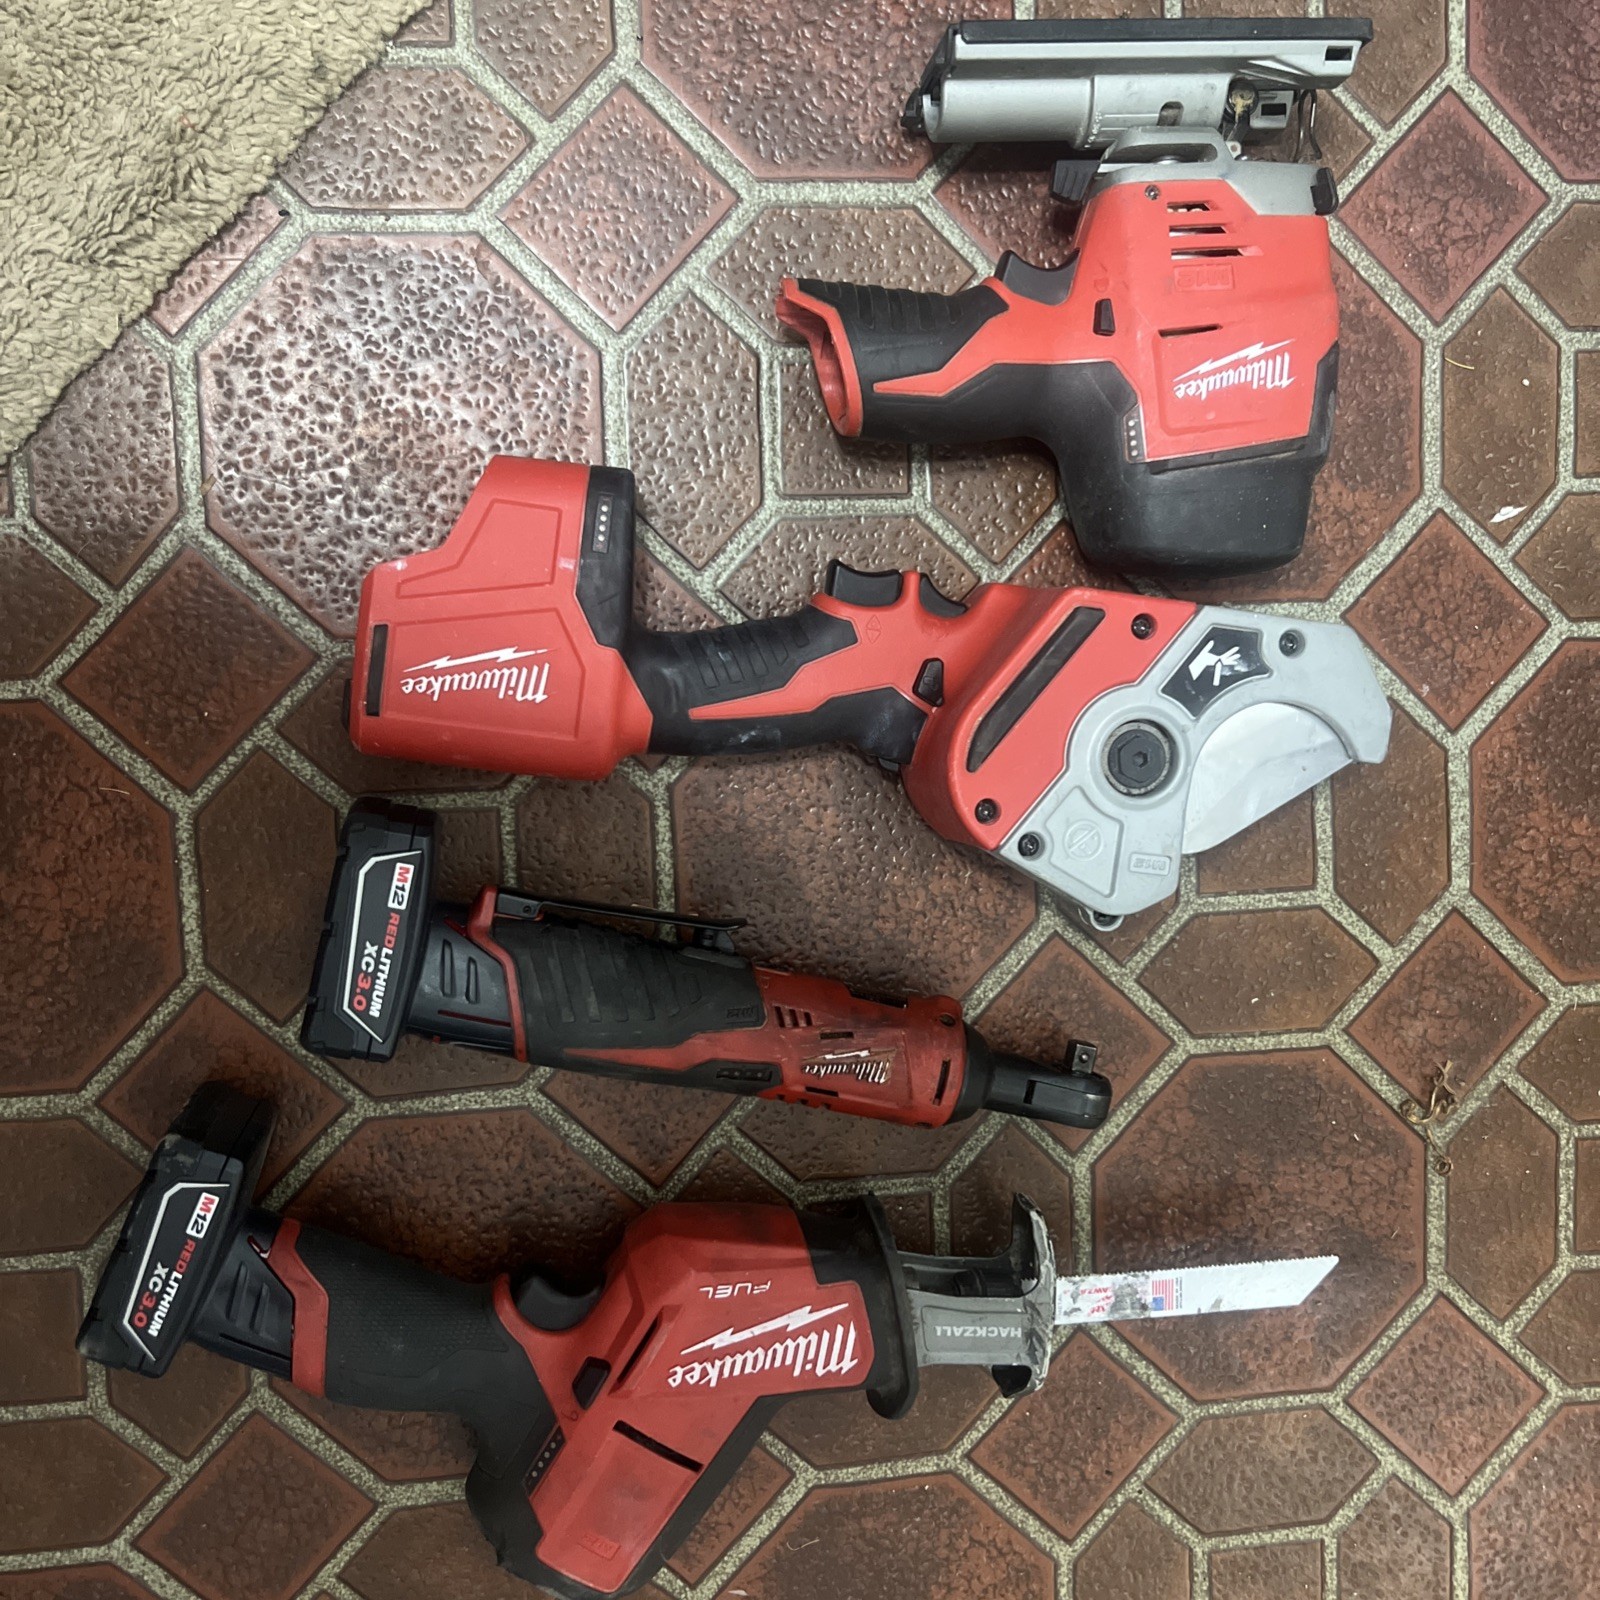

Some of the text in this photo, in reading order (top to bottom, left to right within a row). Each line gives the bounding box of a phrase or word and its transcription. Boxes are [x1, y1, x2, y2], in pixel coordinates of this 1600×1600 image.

[1173, 351, 1297, 401] Milwaukee
[400, 662, 551, 704] Milwaukee
[1133, 857, 1167, 871] M12
[391, 865, 411, 908] M12
[190, 1195, 215, 1236] M12
[699, 1280, 771, 1299] FUEL
[934, 1325, 1022, 1338] HACKZALL
[667, 1320, 859, 1388] Milwaukee
